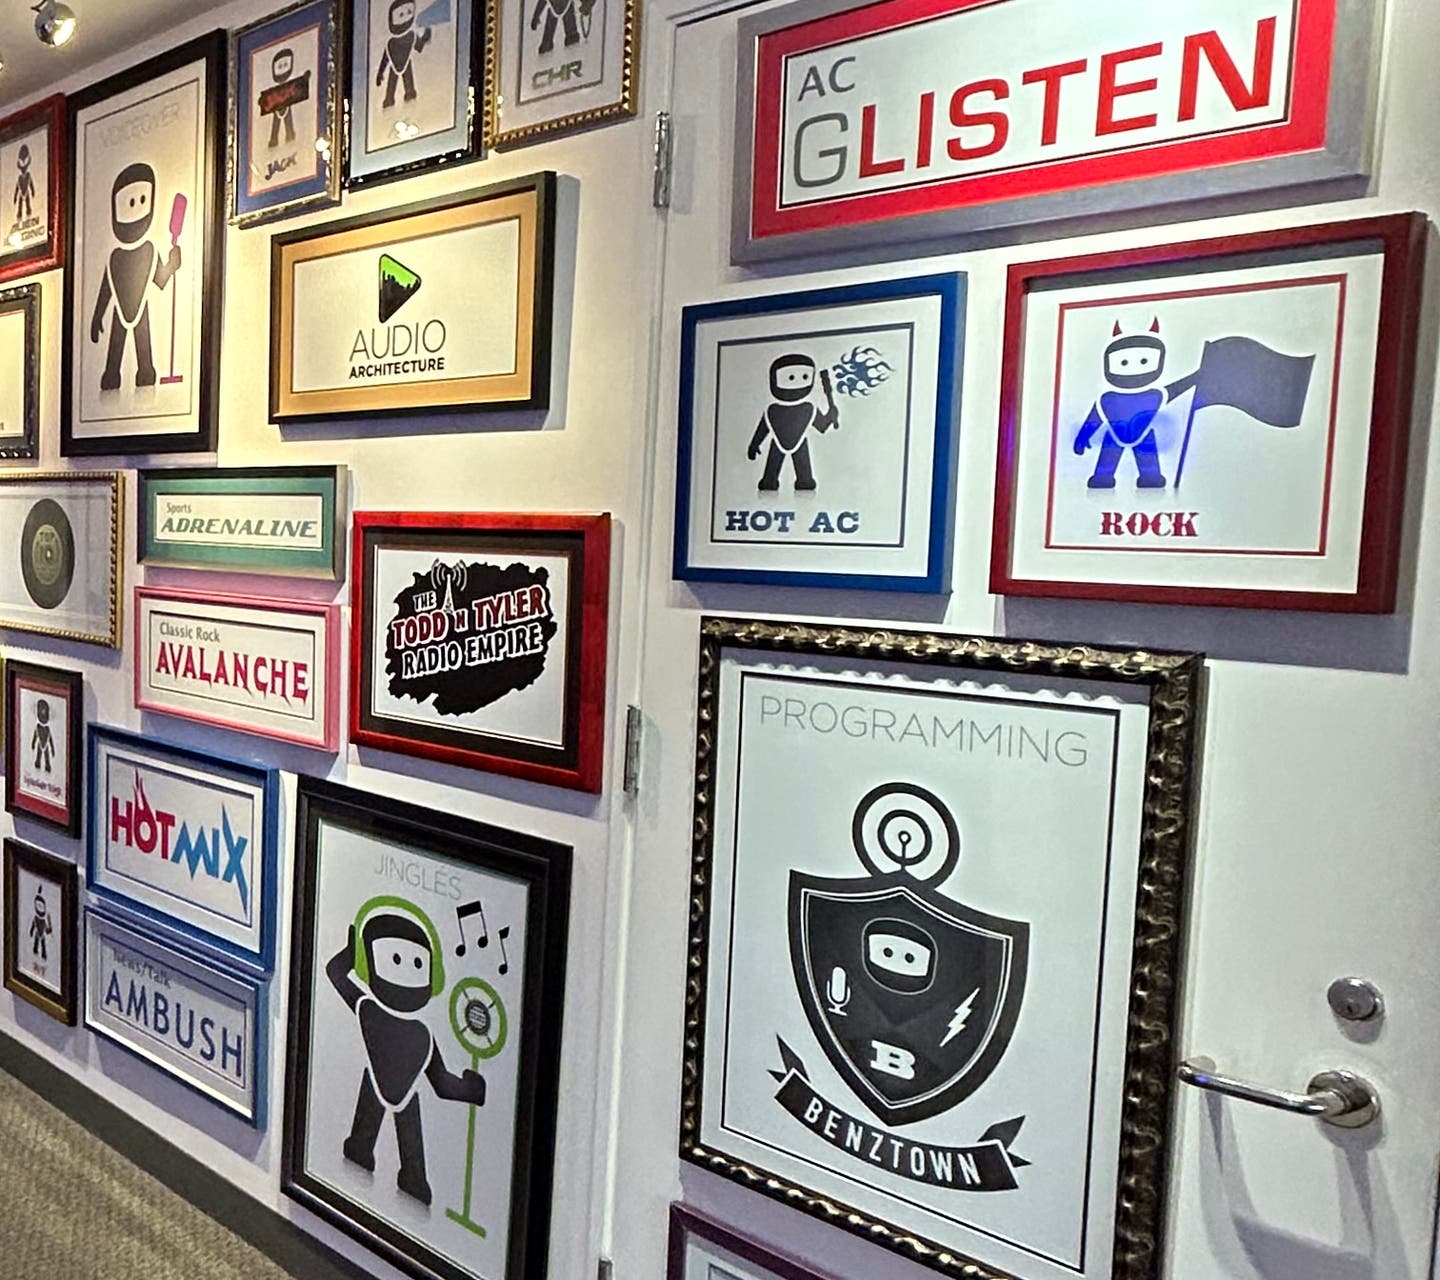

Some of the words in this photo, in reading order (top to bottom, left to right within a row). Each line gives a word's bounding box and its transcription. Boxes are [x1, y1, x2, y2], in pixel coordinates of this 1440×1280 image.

[531, 59, 582, 91] CHR
[798, 56, 857, 102] AC
[793, 17, 1277, 188] GLISTEN
[265, 152, 297, 181] JACK
[349, 319, 446, 362] AUDIO
[348, 357, 445, 380] ARCHITECTURE
[161, 517, 318, 538] ADRENALINE
[166, 502, 192, 515] Sports
[725, 510, 795, 533] HOT
[809, 511, 860, 534] AC
[1100, 511, 1200, 538] ROCK
[392, 611, 448, 649] TODD
[472, 584, 548, 630] TYLER
[413, 591, 437, 612] THE
[160, 622, 193, 639] Classic
[196, 627, 220, 643] Rock
[402, 641, 461, 679] RADIO
[465, 623, 544, 667] EMPIRE
[156, 641, 309, 707] AVALANCHE
[759, 694, 1088, 768] PROGRAMMING
[374, 853, 463, 901] JINGLES
[113, 948, 171, 989] News/Talk
[105, 971, 242, 1078] AMBUSH
[870, 1040, 915, 1080] B
[805, 1097, 983, 1185] BENZTOWN
